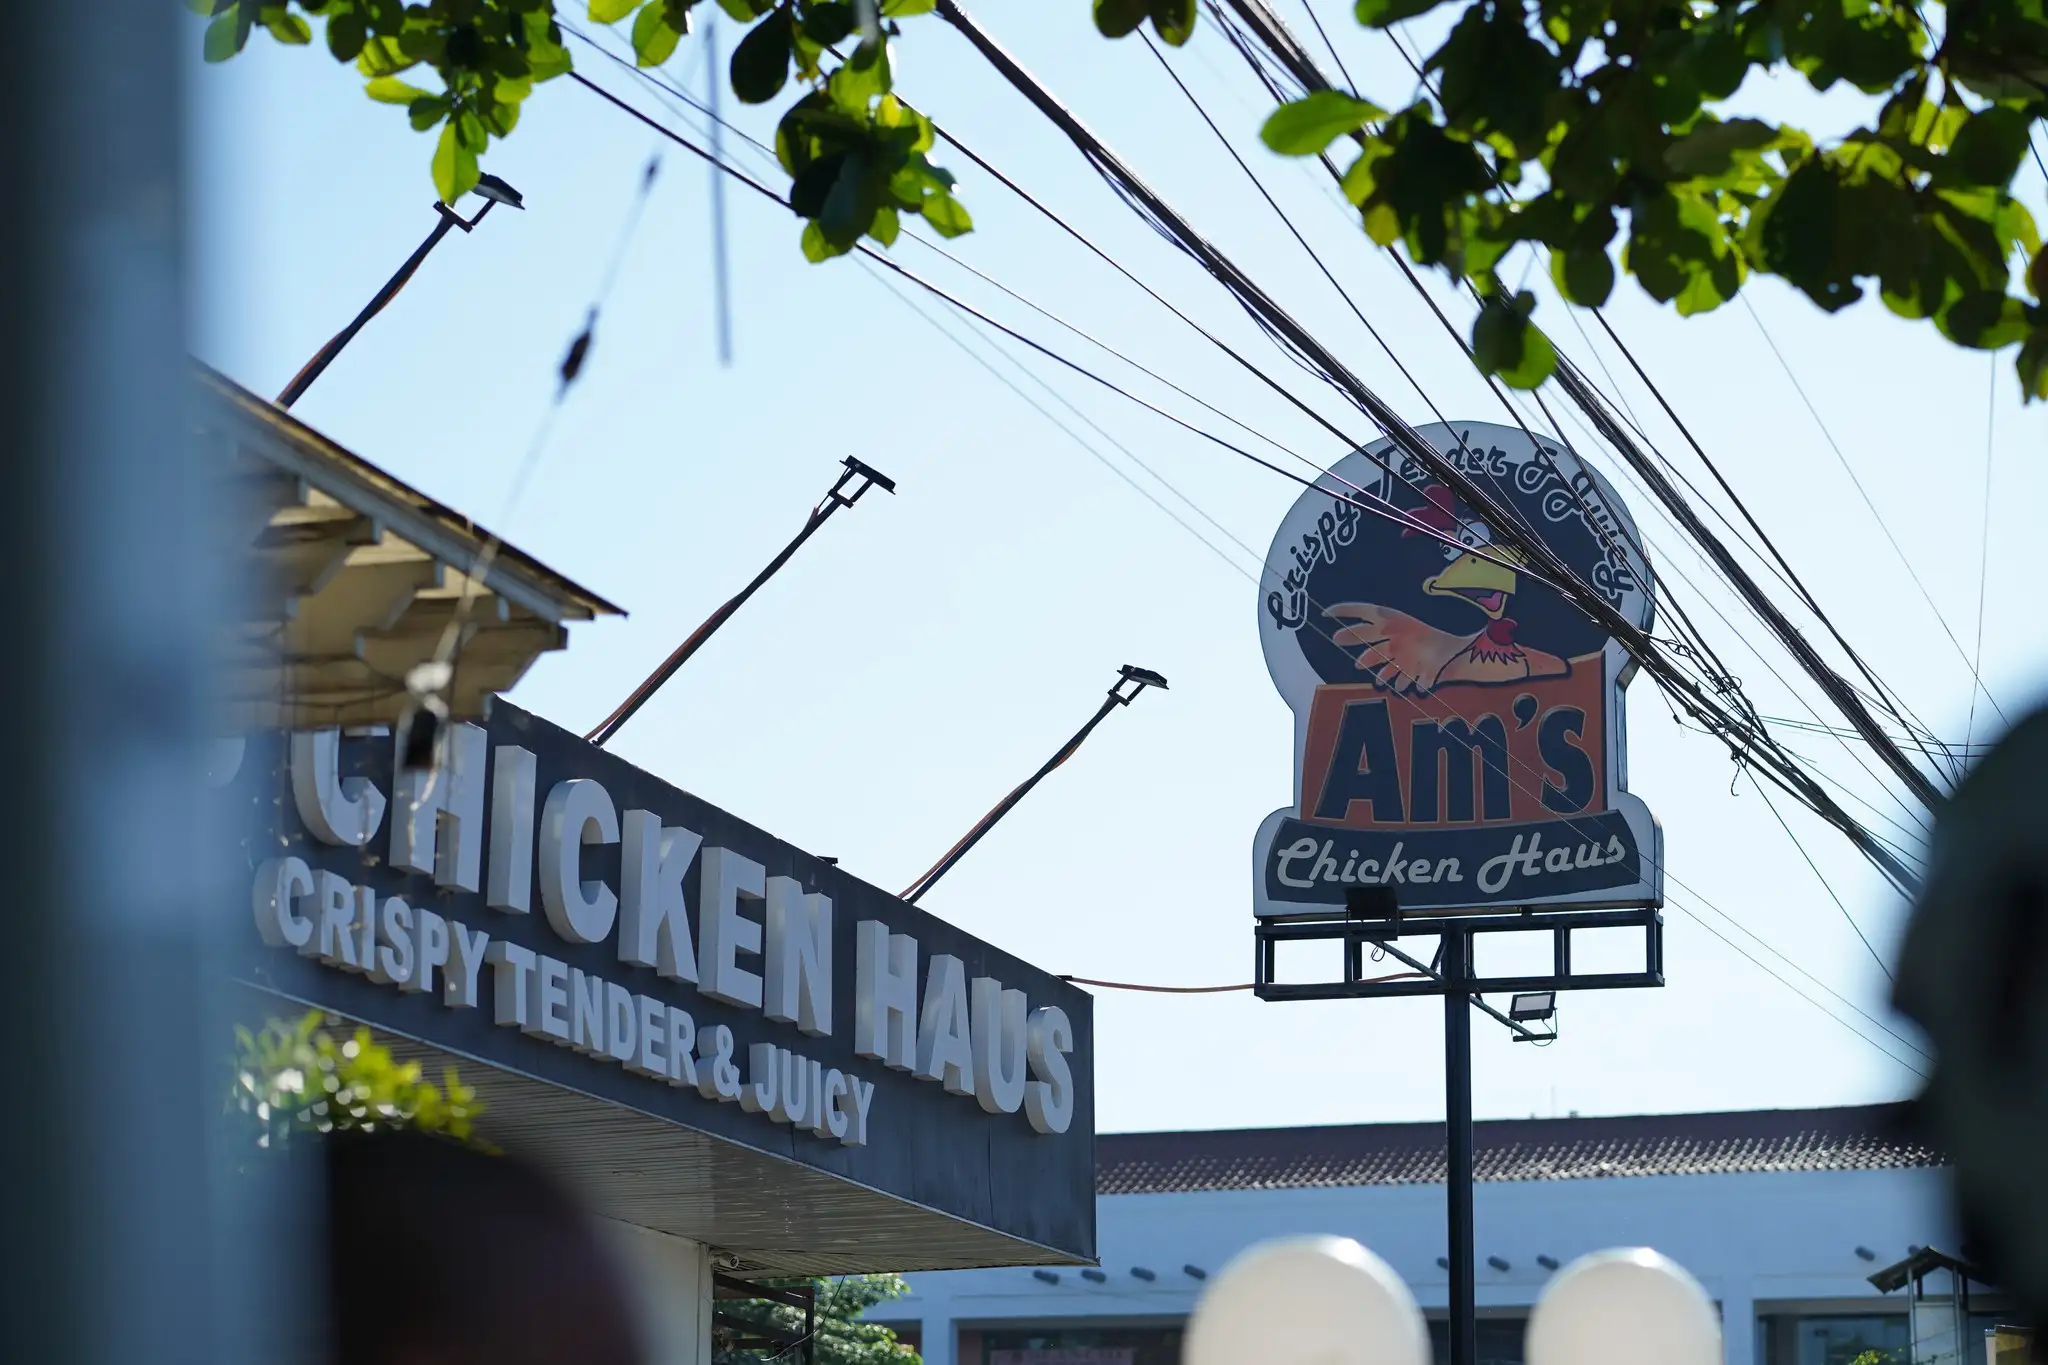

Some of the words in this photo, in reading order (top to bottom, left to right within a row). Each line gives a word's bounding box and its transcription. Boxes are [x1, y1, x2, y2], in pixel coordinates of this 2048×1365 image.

[1267, 491, 1361, 631] Crispy
[1374, 429, 1508, 505] Teder
[1515, 446, 1560, 494] &
[290, 720, 832, 1037] CHICKEN
[855, 919, 1074, 1134] HAUS
[1276, 836, 1464, 889] Chicken
[1476, 831, 1627, 894] Haus
[252, 856, 490, 1008] CRISPY
[484, 940, 698, 1087] TENDER
[696, 1024, 743, 1103] &
[739, 1042, 875, 1146] JUICY
